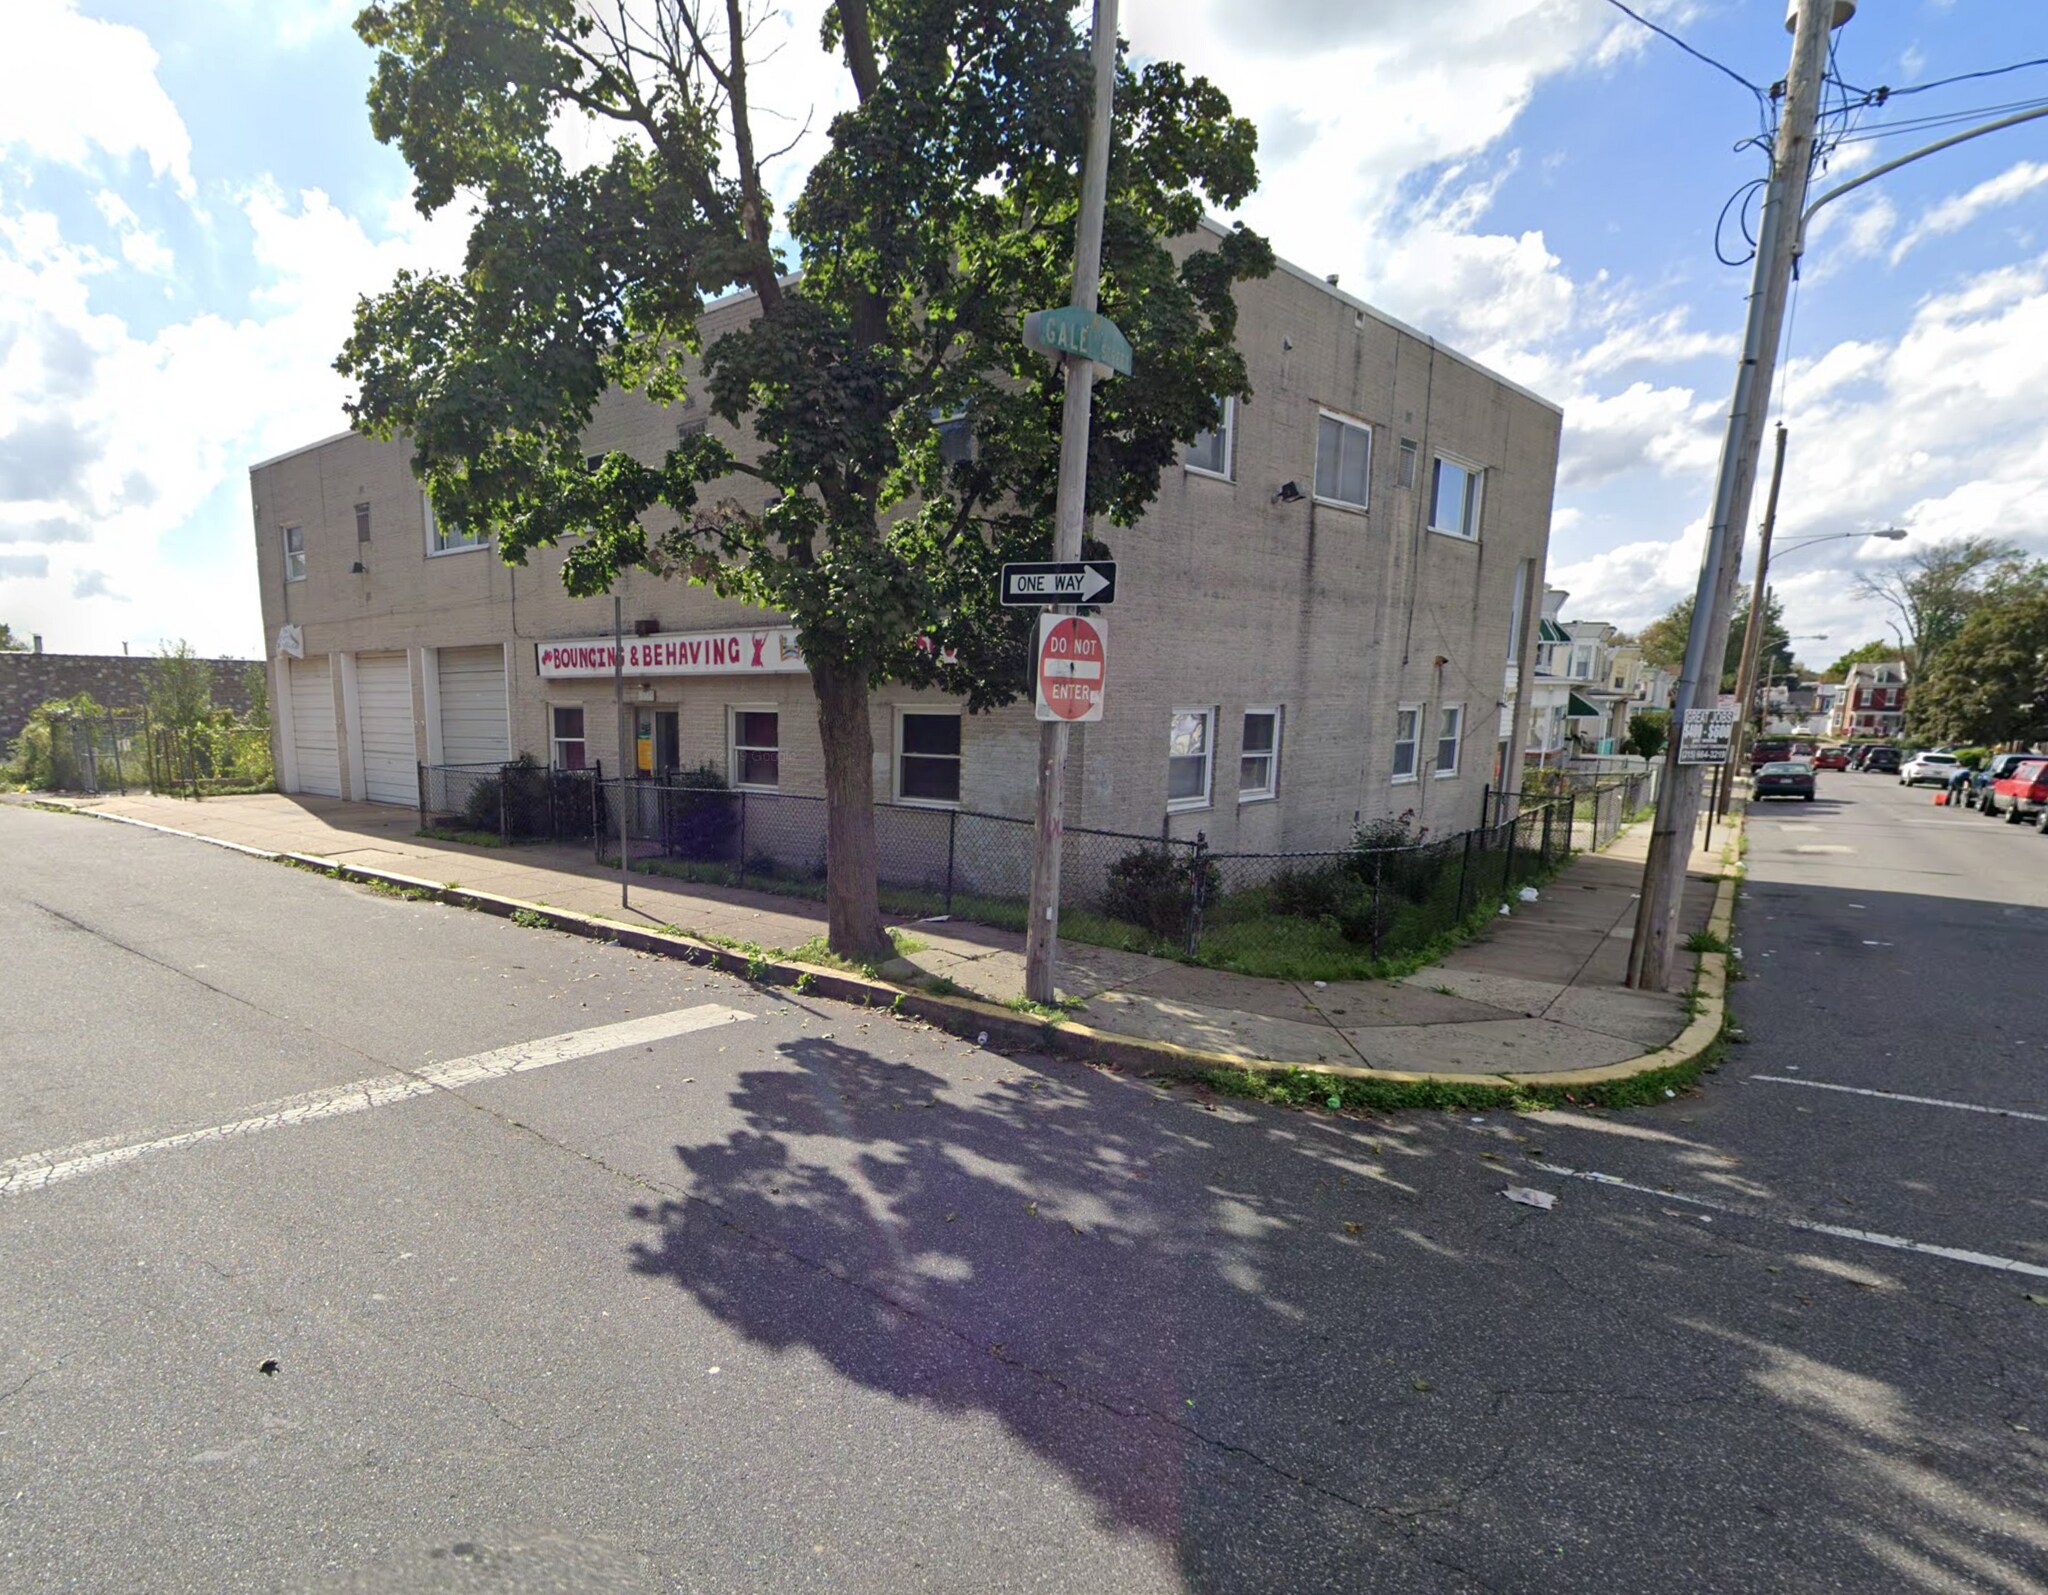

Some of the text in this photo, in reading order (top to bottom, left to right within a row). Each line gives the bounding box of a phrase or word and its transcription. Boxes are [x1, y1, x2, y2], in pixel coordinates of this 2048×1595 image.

[1046, 317, 1090, 353] GALE
[1017, 575, 1085, 592] ONE WAY
[630, 645, 640, 667] &
[642, 637, 740, 666] BEHAVING
[1051, 637, 1097, 655] DO NOT
[1053, 684, 1089, 700] ENTER
[1686, 711, 1733, 724] GREAT JOBS
